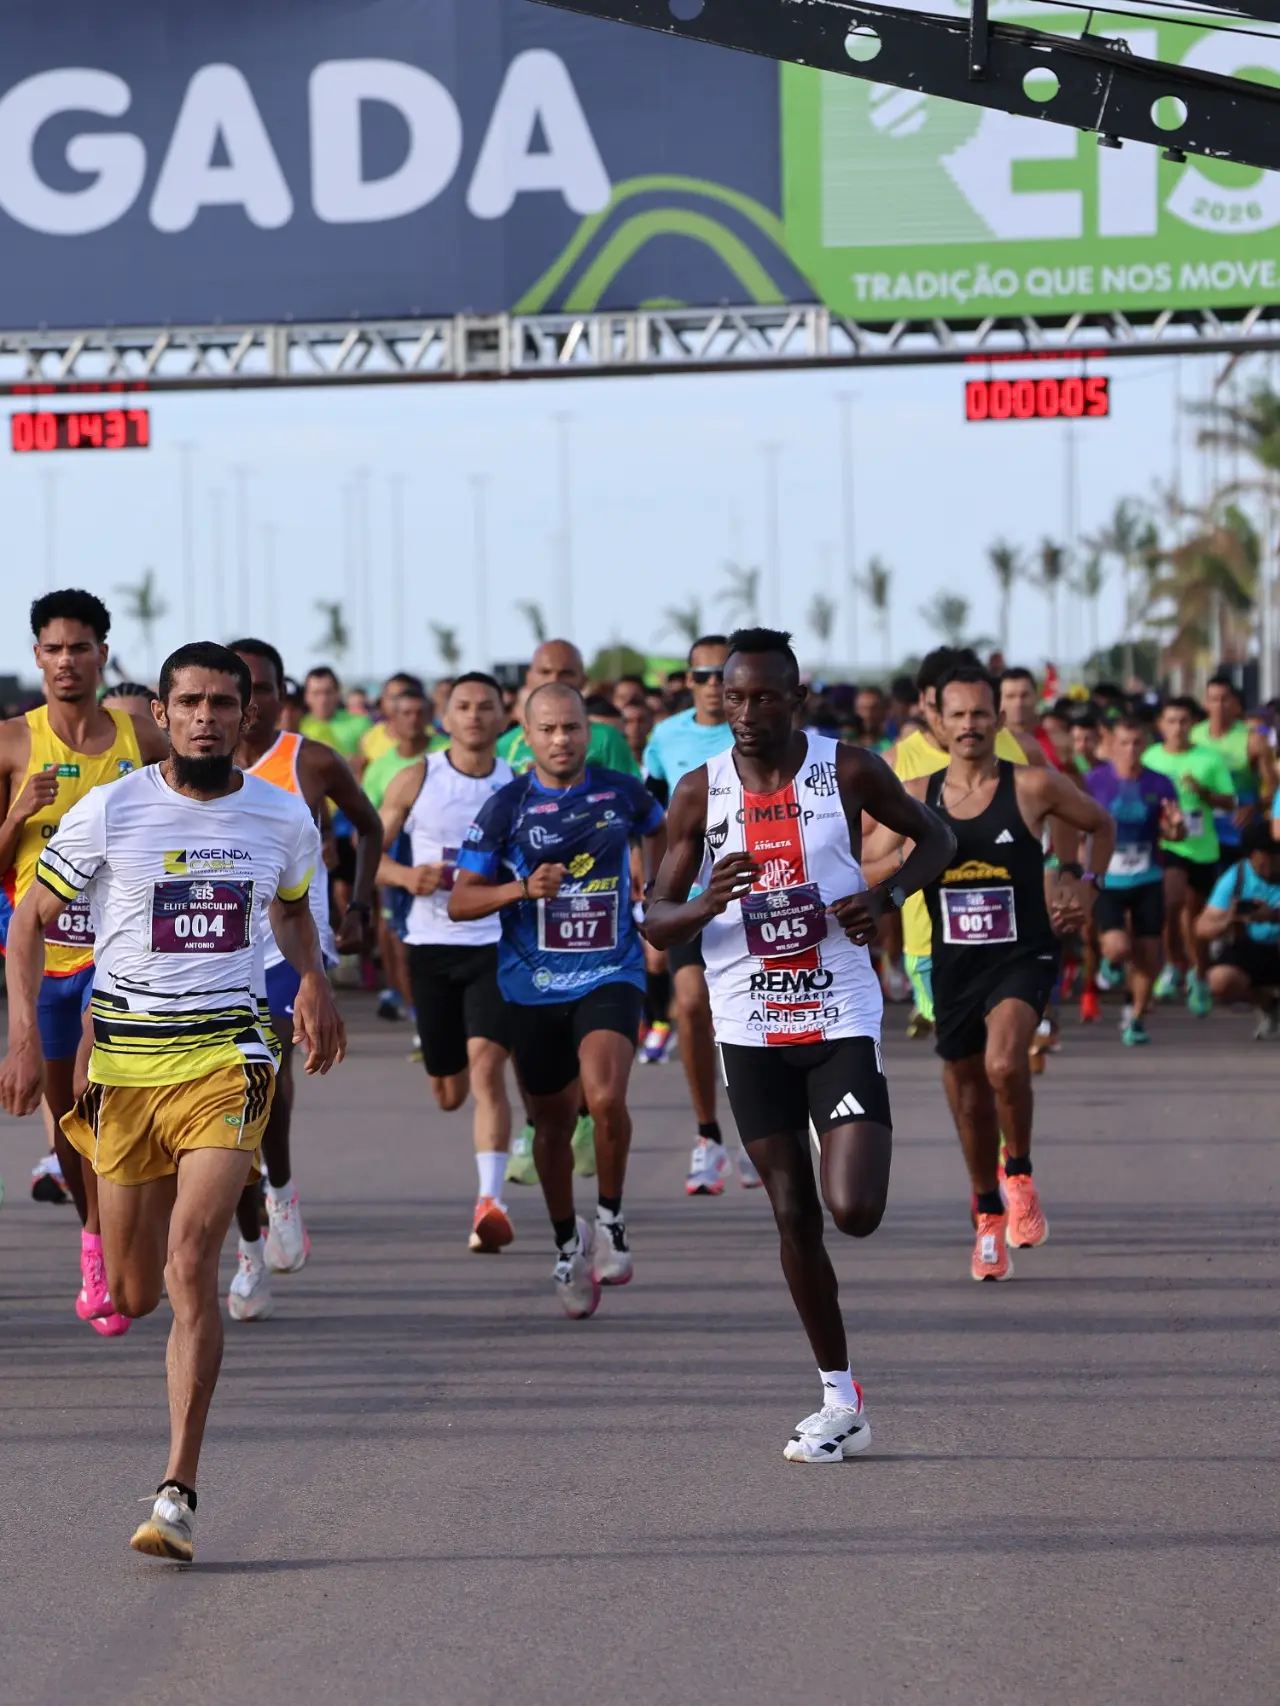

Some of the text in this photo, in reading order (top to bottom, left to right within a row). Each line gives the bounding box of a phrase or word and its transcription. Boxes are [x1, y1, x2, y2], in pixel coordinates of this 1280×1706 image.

[1191, 196, 1263, 223] 2026
[851, 261, 1018, 303] TRADIÇÃO
[1024, 263, 1095, 297] QUE
[1101, 263, 1173, 294] NOS
[735, 802, 802, 825] CIMED
[708, 832, 727, 845] THV
[189, 848, 252, 860] AGENDA
[189, 860, 236, 870] CASH
[163, 902, 238, 911] ELITE MASCULINA
[749, 903, 815, 920] ELITE MASCULINA
[174, 914, 226, 938] 004
[560, 920, 599, 938] 017
[761, 916, 809, 943] 045
[958, 913, 994, 932] 001
[775, 942, 800, 951] WILSON
[749, 968, 834, 994] REMO
[750, 990, 835, 1002] ENGENHARIA
[748, 1006, 840, 1022] ARISTO
[746, 1017, 840, 1032] CONSTRUTORA
